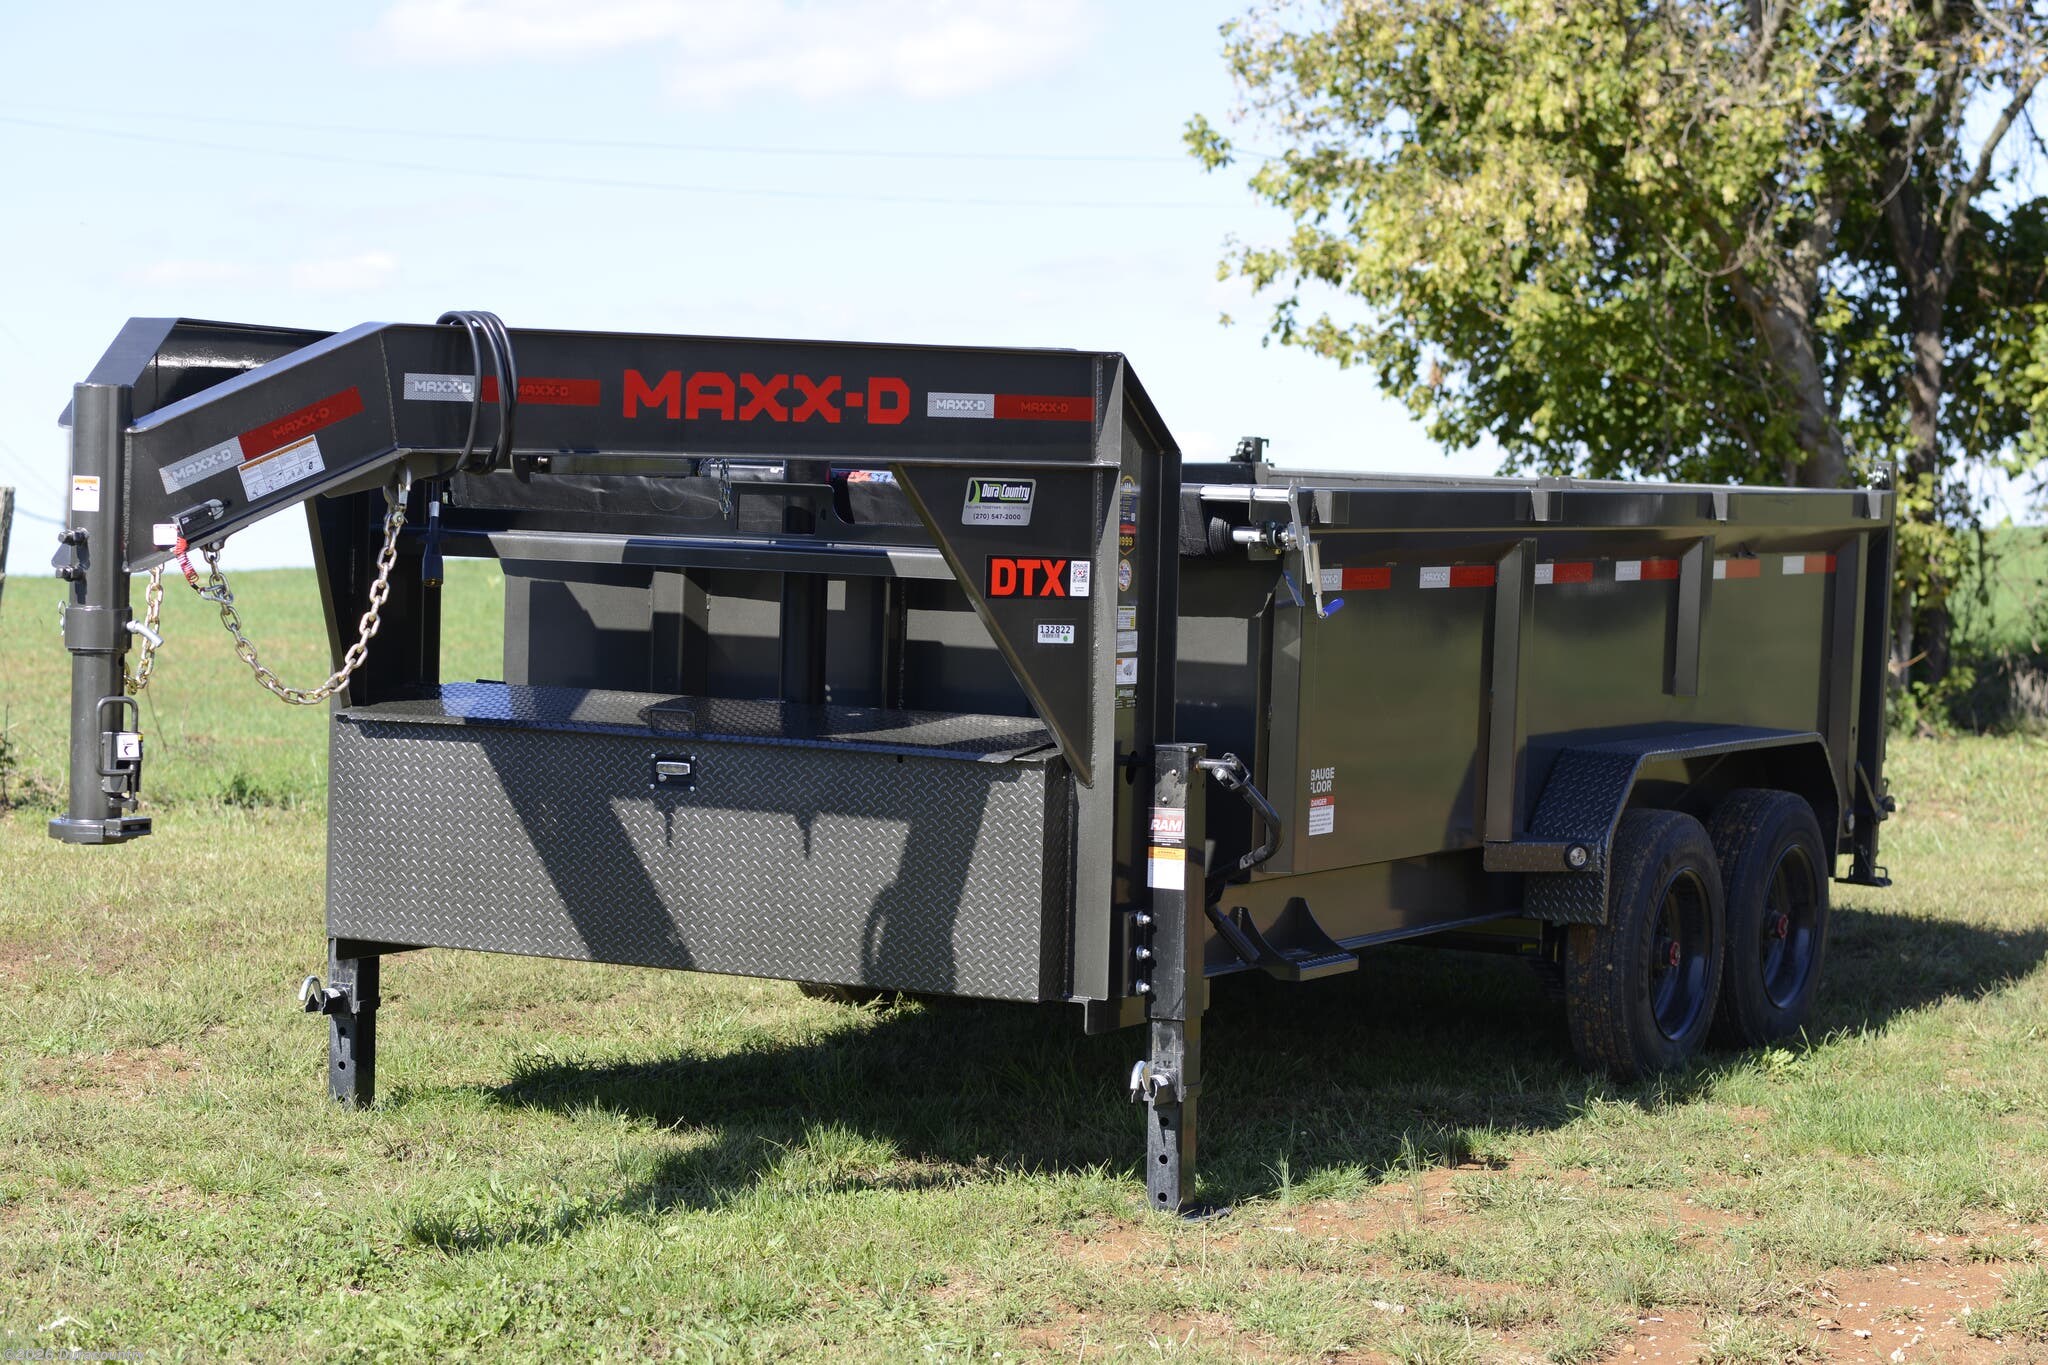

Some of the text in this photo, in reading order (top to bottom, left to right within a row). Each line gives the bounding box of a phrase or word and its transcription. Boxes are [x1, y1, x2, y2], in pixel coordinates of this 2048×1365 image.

[413, 380, 472, 394] MAXX-D
[624, 369, 911, 425] MAXX-D
[935, 399, 986, 411] MAXX-D
[1020, 401, 1069, 413] MAXX-D
[271, 406, 330, 439] MAXX-D
[171, 449, 233, 483] MAXX-D
[982, 483, 1031, 501] Dura Country
[973, 513, 1022, 521] (270) 547-2000
[991, 558, 1067, 597] DTX
[1039, 625, 1071, 634] 132822
[1310, 766, 1335, 781] GAUGE
[1150, 818, 1183, 832] RAM
